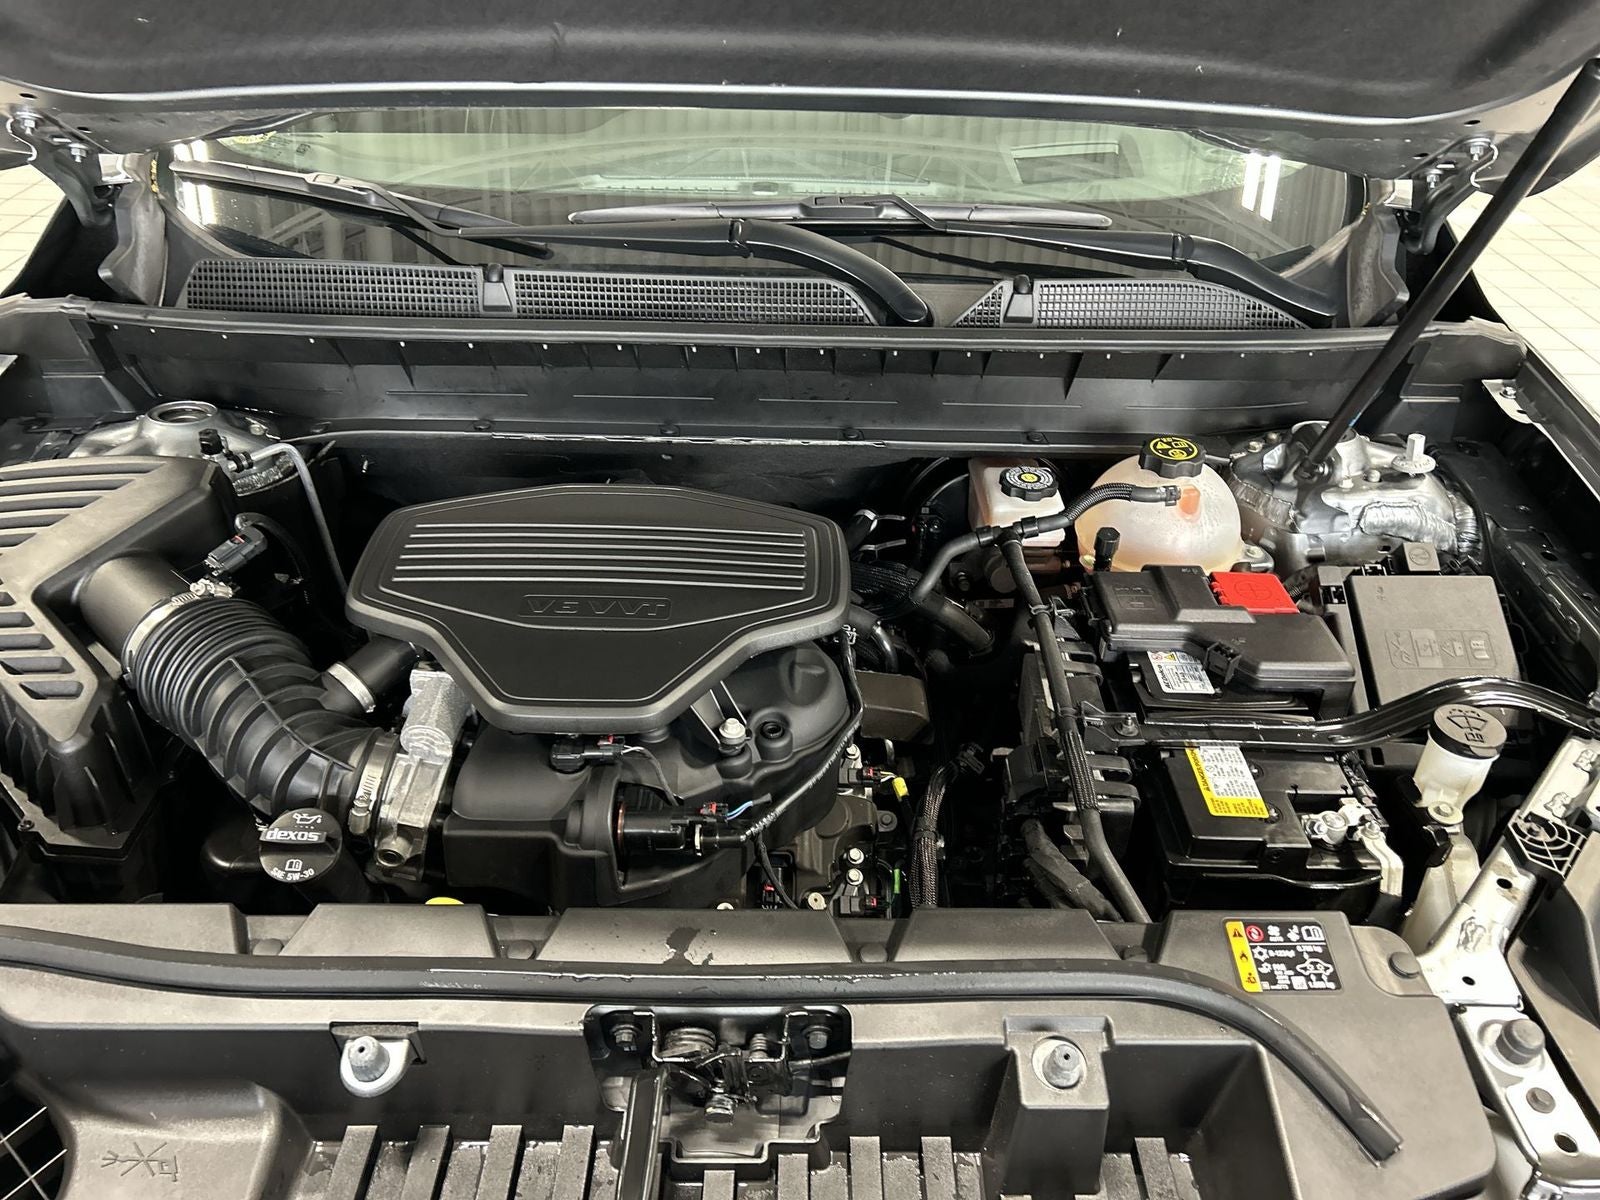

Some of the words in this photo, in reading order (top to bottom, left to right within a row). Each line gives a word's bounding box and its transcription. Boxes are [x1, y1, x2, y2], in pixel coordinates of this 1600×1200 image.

[587, 599, 667, 616] VVT
[265, 827, 321, 842] dexos
[271, 867, 286, 879] SAE
[286, 868, 315, 881] 5W-30
